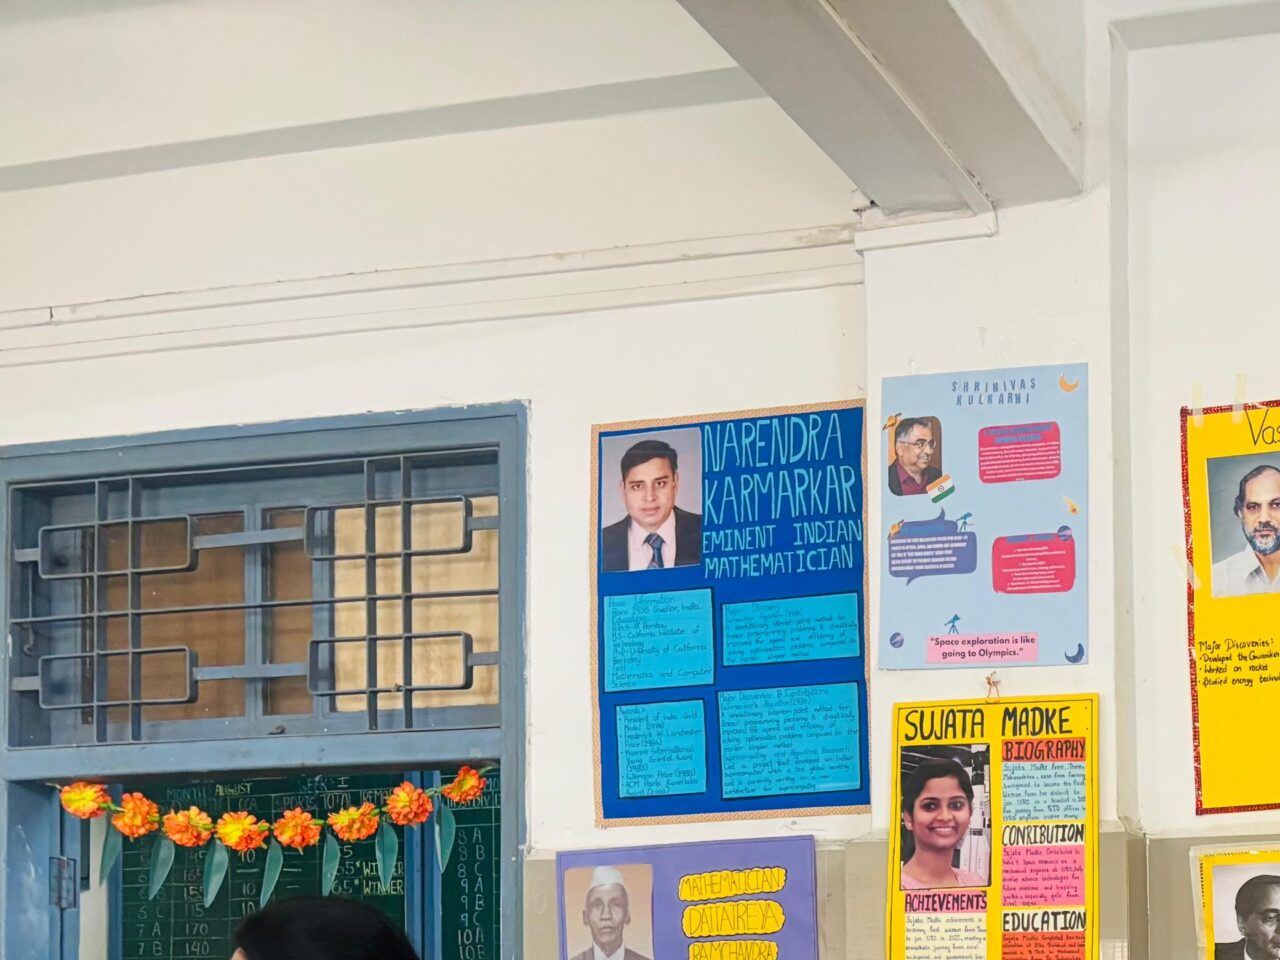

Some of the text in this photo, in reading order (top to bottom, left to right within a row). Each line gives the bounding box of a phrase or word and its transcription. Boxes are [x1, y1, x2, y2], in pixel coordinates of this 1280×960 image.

[704, 413, 843, 472] NARENDRA
[704, 465, 855, 525] KARMARKAR
[703, 519, 862, 553] EMINENT INDIAN
[705, 544, 853, 578] MATHEMATICIAN
[930, 636, 1035, 647] "Space exploration is like
[1199, 641, 1221, 654] Major
[942, 647, 1023, 659] going to Olympics."
[905, 707, 1072, 741] SUJATA MADKE
[1004, 739, 1085, 760] BIOGRAPHY
[215, 782, 254, 796] AUGUST
[475, 877, 483, 892] A
[681, 869, 781, 896] MATHEMATICIAN
[905, 893, 987, 912] ACHIEVEMENTS
[689, 903, 778, 935] DATTATREYA
[1003, 910, 1086, 932] EDUCATION
[185, 924, 208, 936] 170
[185, 942, 210, 956] 140
